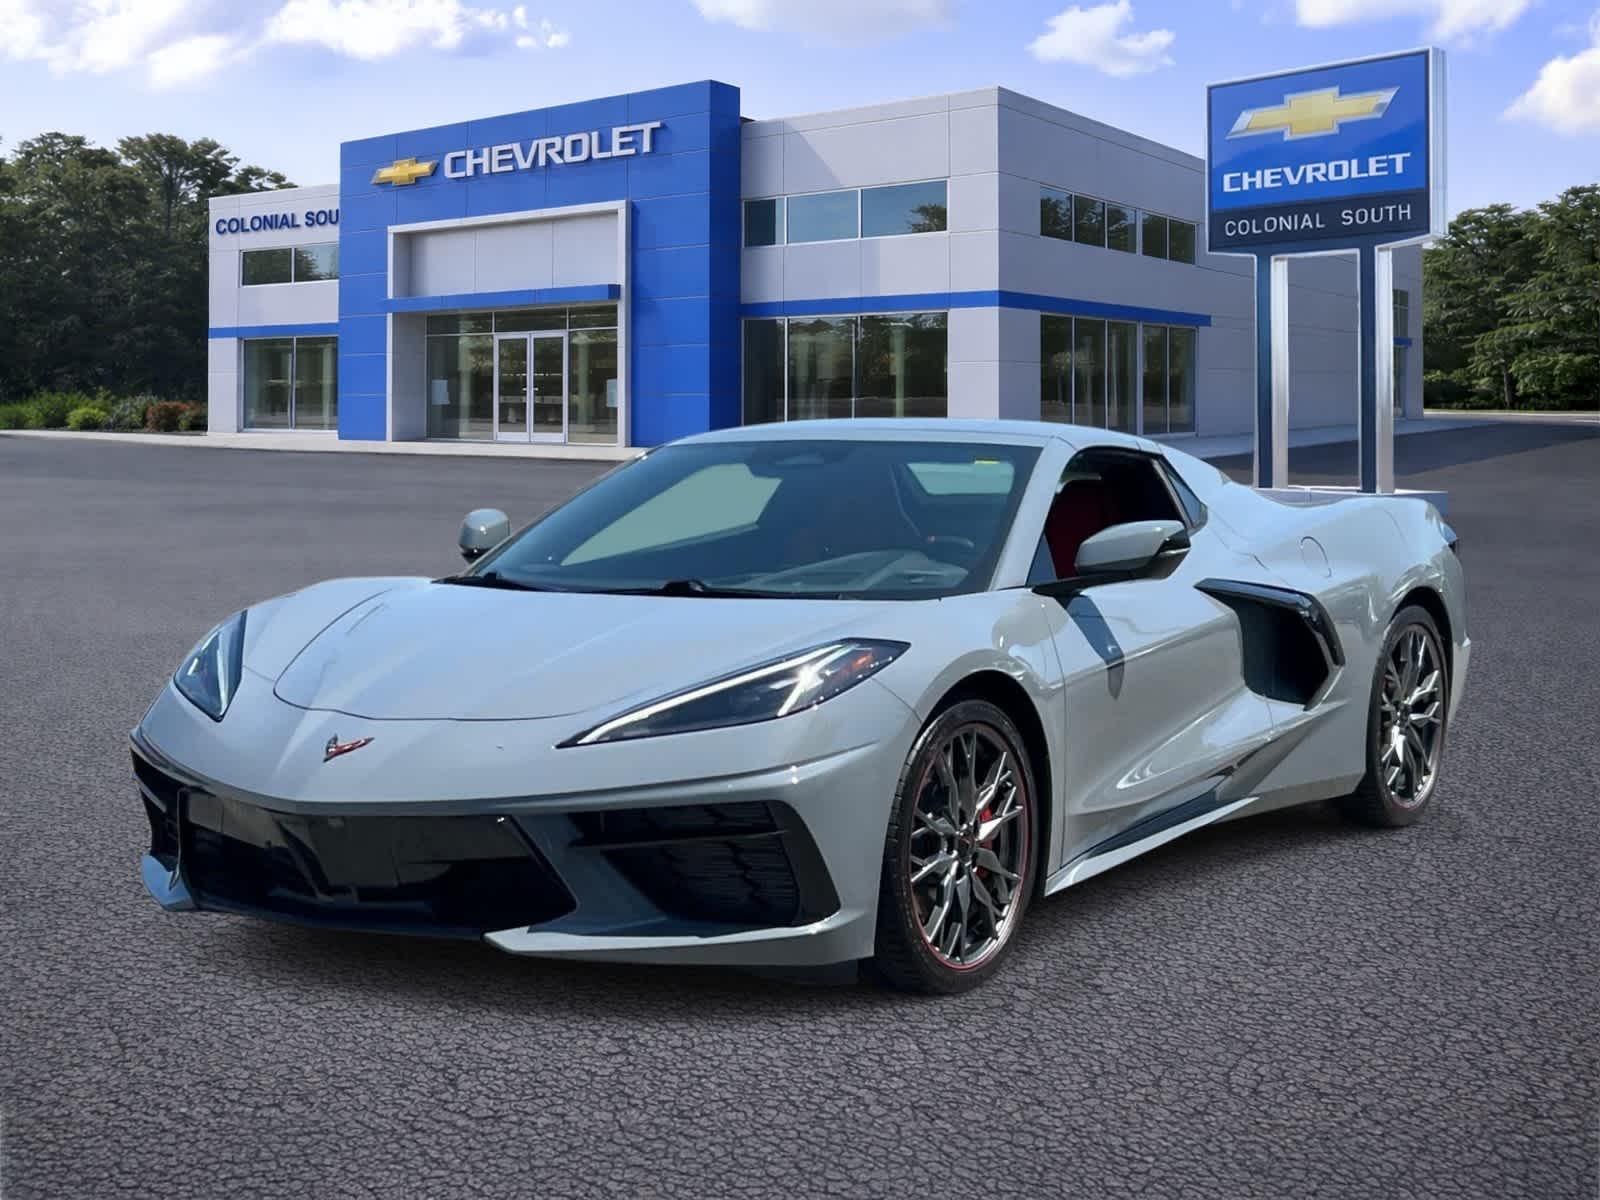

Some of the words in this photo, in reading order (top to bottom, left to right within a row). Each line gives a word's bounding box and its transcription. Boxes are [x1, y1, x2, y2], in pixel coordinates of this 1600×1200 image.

[444, 121, 661, 178] CHEVROLET
[1223, 152, 1411, 193] CHEVROLET
[215, 213, 301, 235] COLONIAL
[1225, 213, 1325, 236] COLONIAL
[1341, 204, 1411, 225] SOUTH
